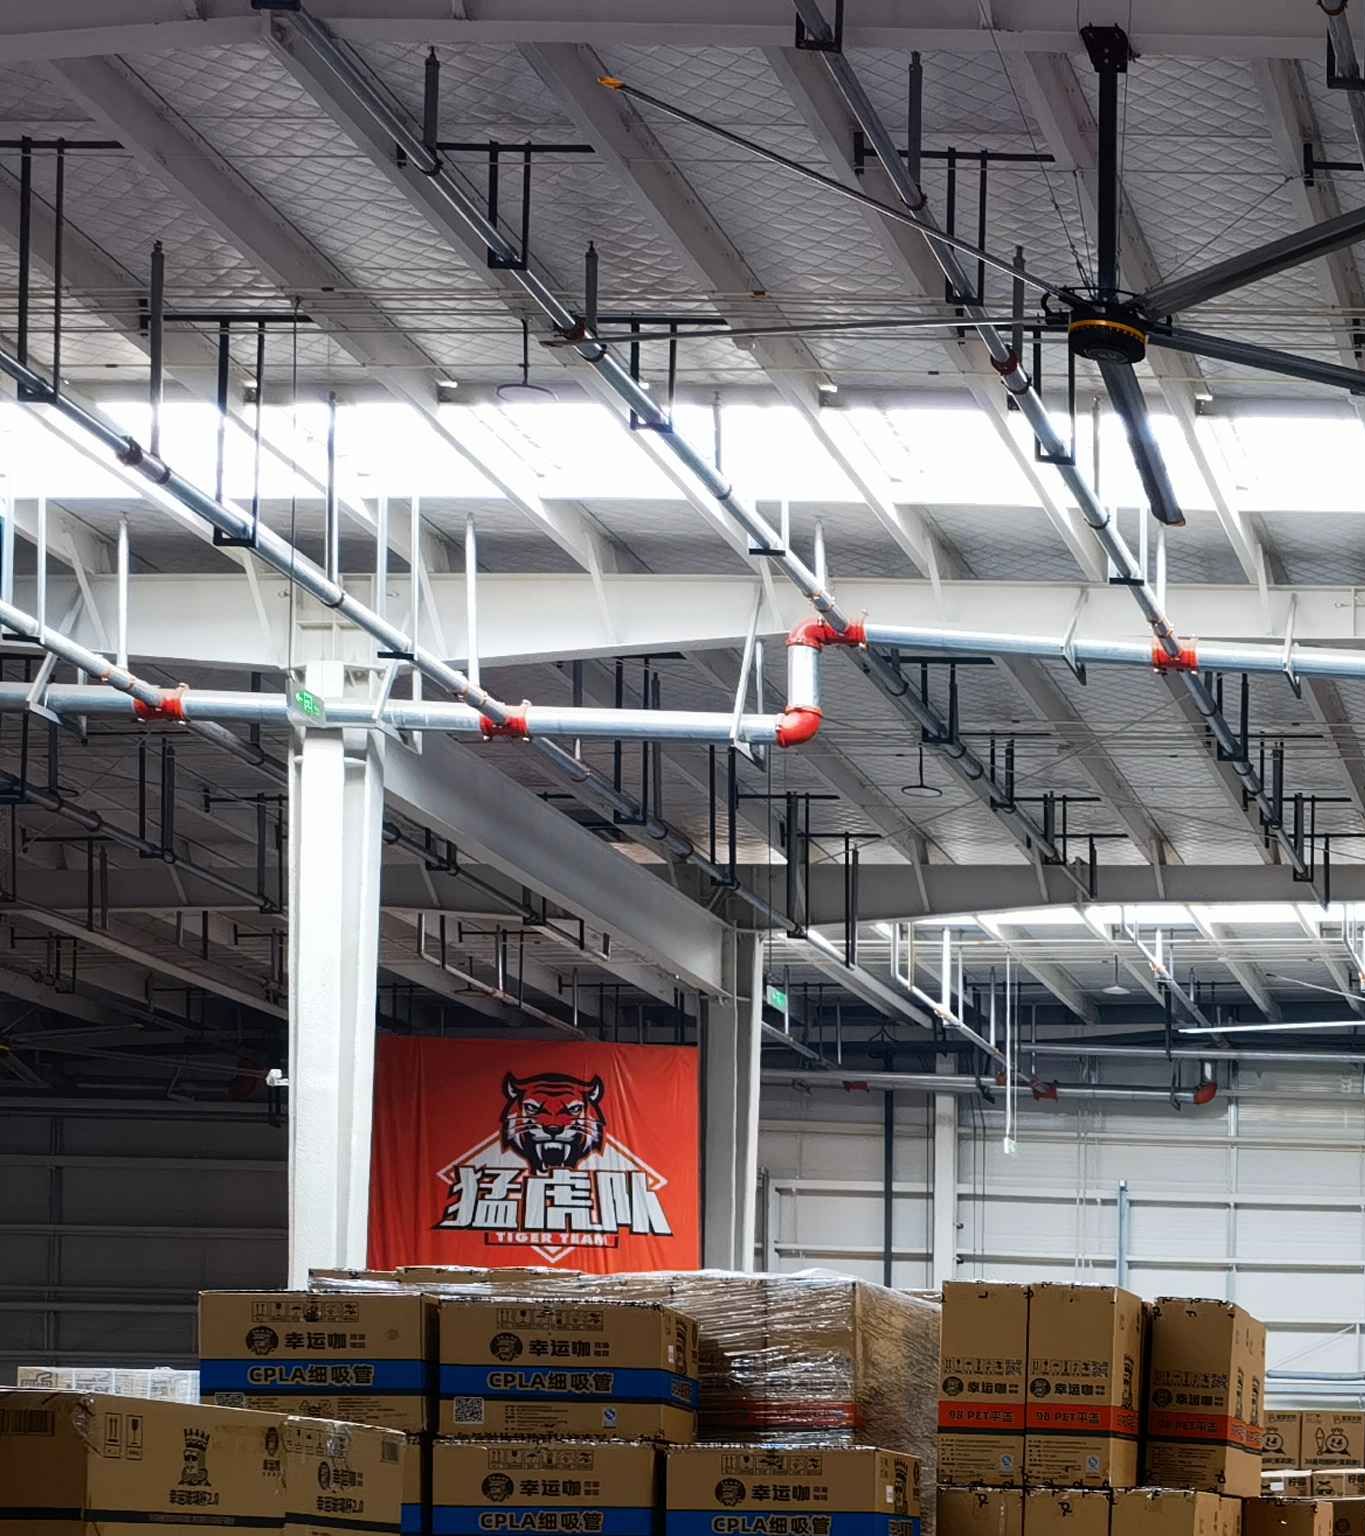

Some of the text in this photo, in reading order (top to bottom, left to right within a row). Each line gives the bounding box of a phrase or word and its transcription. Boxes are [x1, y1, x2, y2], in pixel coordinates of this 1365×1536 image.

[437, 1165, 672, 1235] 猛虎队
[495, 1232, 608, 1247] TIGER TEAM
[284, 1332, 346, 1350] 幸运咖
[528, 1338, 591, 1358] 幸运咖
[249, 1364, 375, 1386] CPLA细吸管
[487, 1372, 614, 1394] CPLA细吸管
[519, 1479, 583, 1498] 幸运咖
[751, 1483, 812, 1502] 幸运咖
[480, 1511, 604, 1532] CPLA细吸管
[712, 1515, 831, 1536] CPLA细吸管
